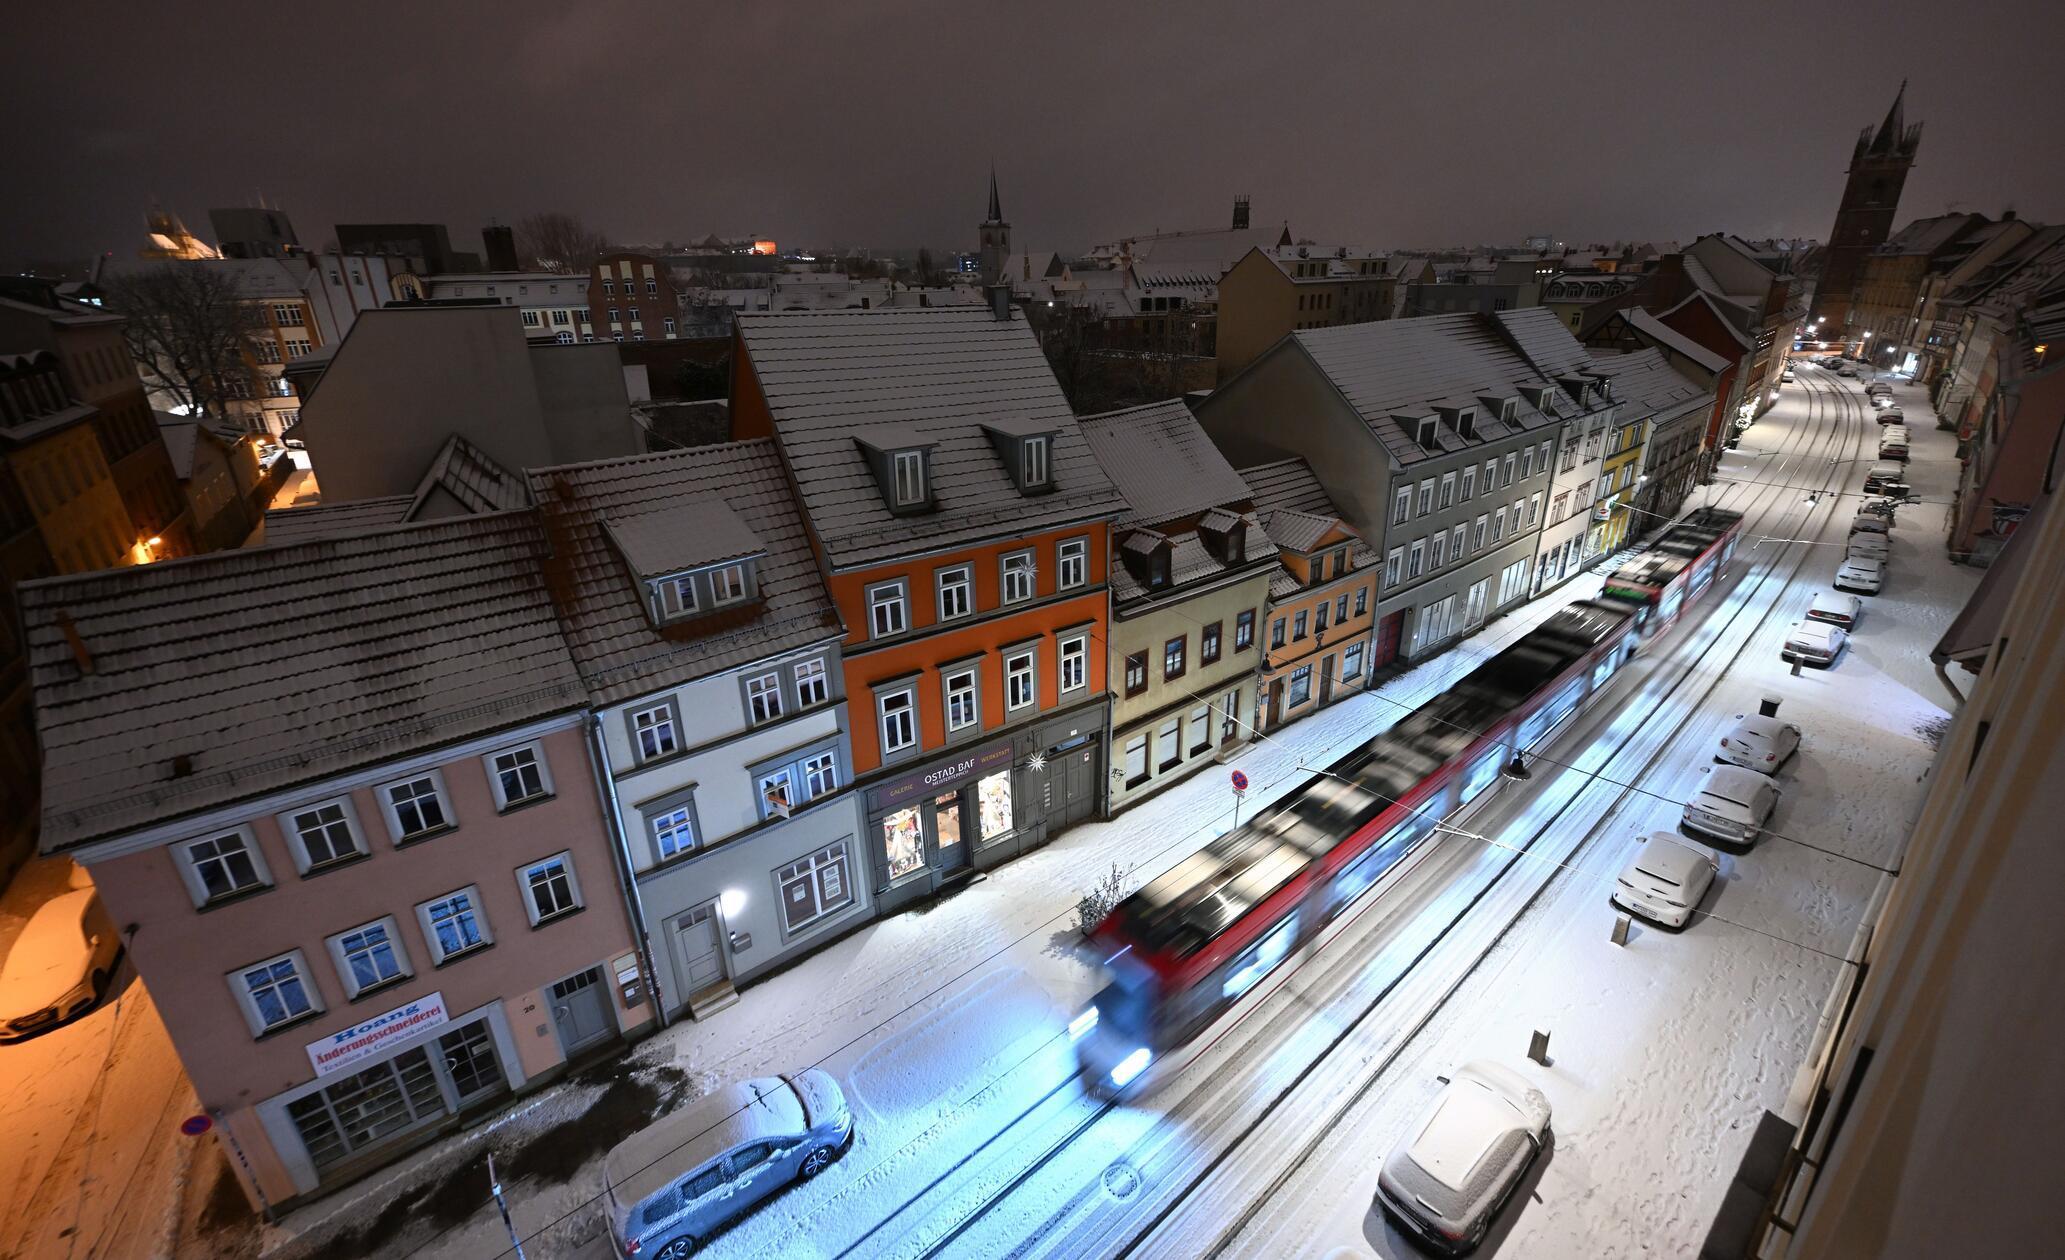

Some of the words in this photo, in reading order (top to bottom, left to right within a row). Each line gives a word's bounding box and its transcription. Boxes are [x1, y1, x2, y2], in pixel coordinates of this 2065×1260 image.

[981, 748, 1010, 763] WERKSTATT
[924, 766, 956, 784] OSTAD
[958, 758, 975, 772] BAF
[932, 770, 969, 786] MEISTERTEPPICH
[890, 784, 913, 797] GALERIE
[523, 1004, 535, 1014] 20
[334, 1004, 421, 1044] Hoang
[316, 1005, 441, 1065] Änderungsschneiderei
[322, 1053, 362, 1072] Textilien
[364, 1047, 371, 1055] &
[373, 1017, 443, 1050] Geschenkartikel
